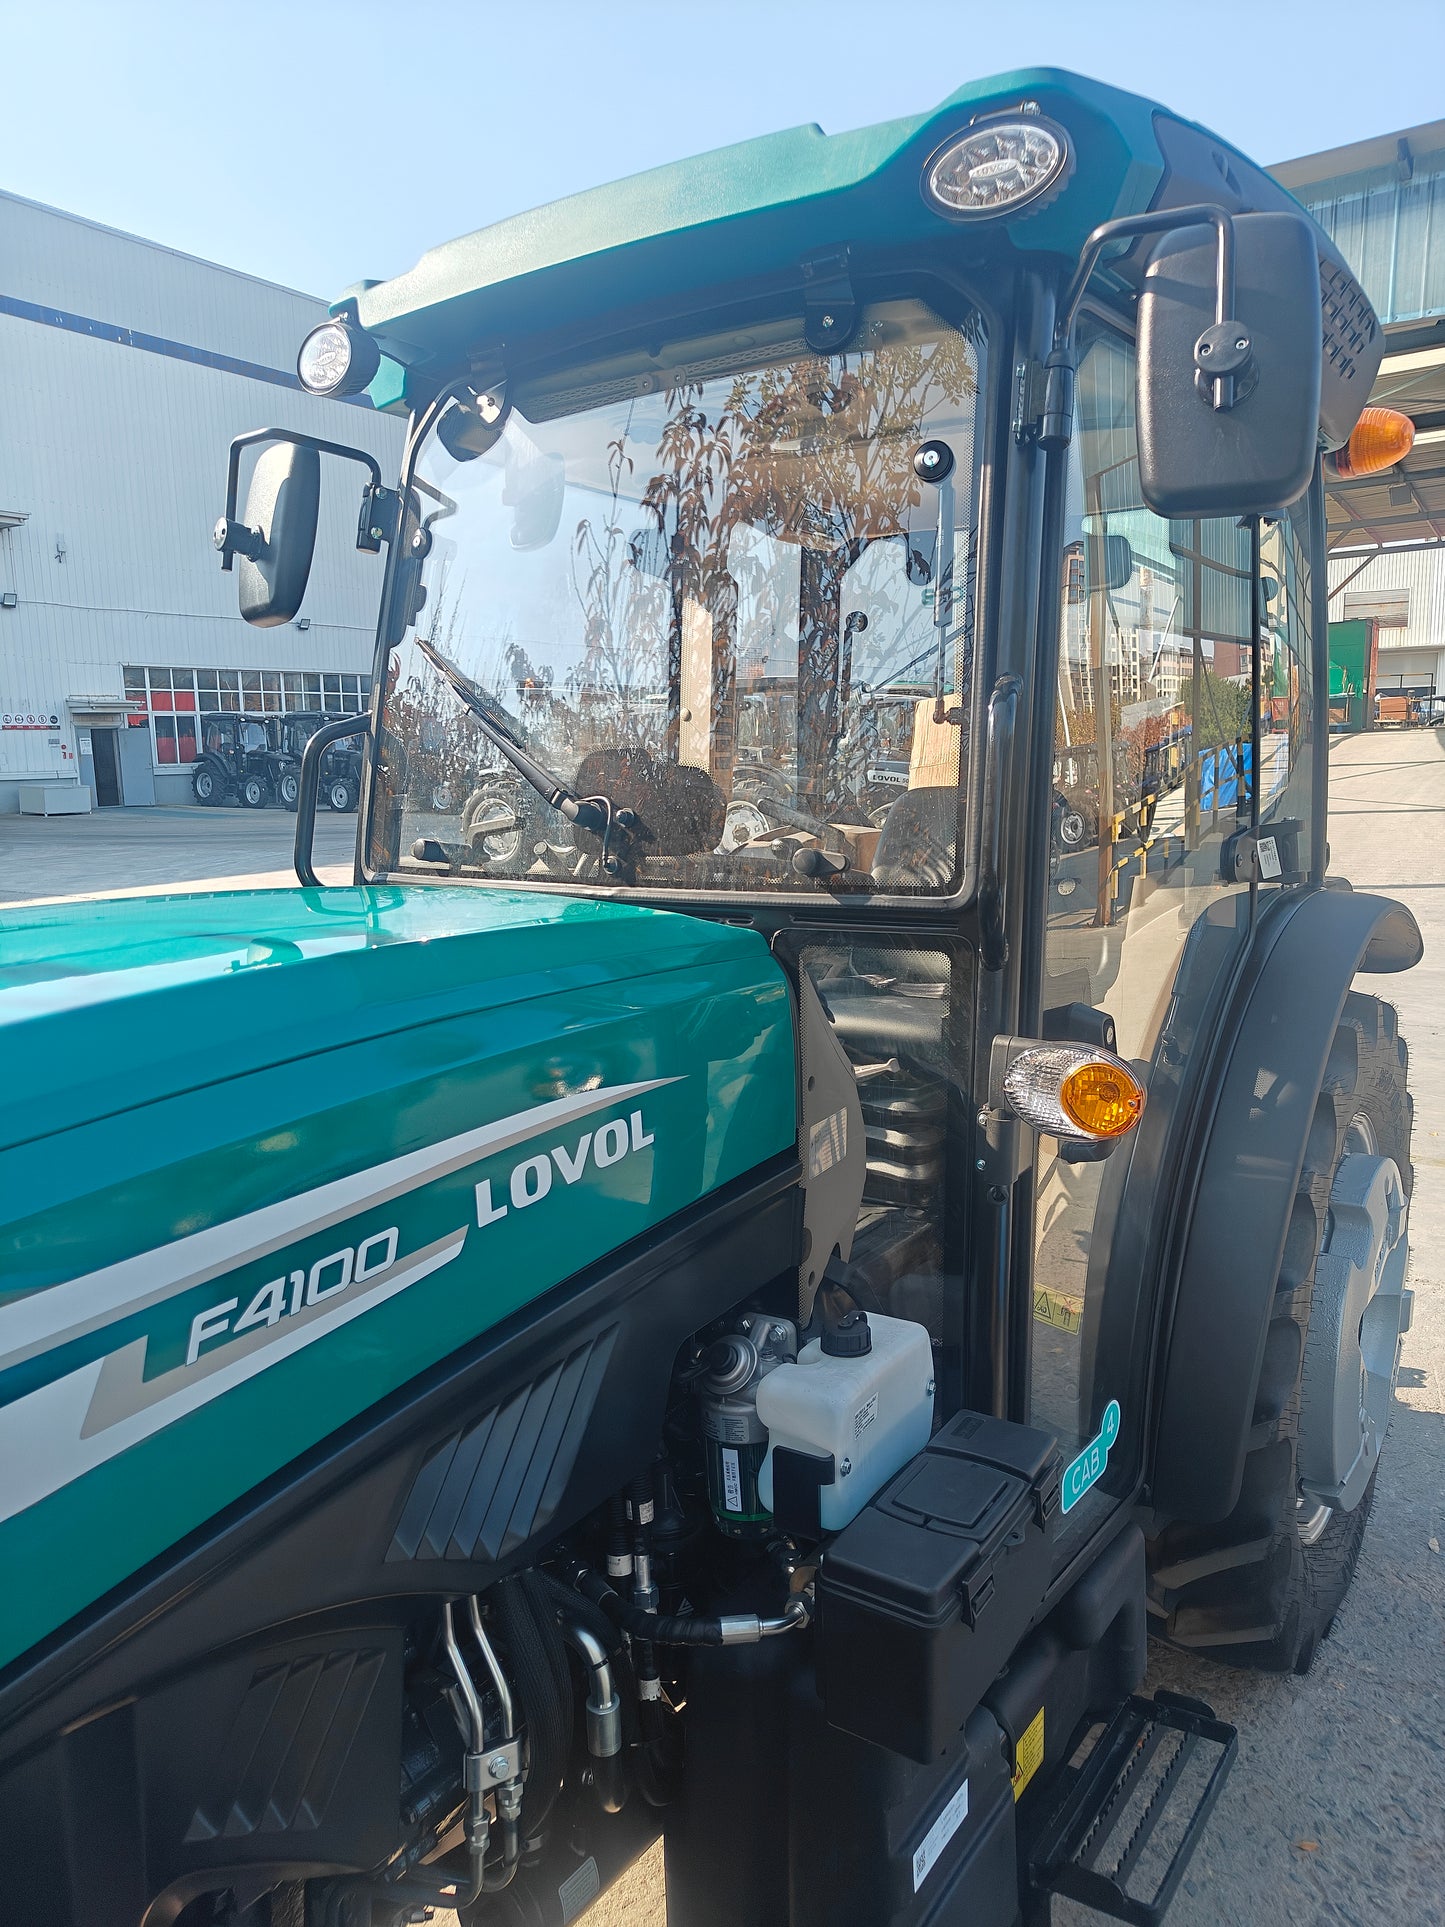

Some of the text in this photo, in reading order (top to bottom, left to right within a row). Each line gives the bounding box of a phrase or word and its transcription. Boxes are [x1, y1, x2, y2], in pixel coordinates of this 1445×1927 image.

[873, 774, 901, 783] LOVOL
[475, 1109, 656, 1228] LOVOL
[185, 1226, 399, 1366] F4100
[1072, 1411, 1115, 1494] CAB 4
